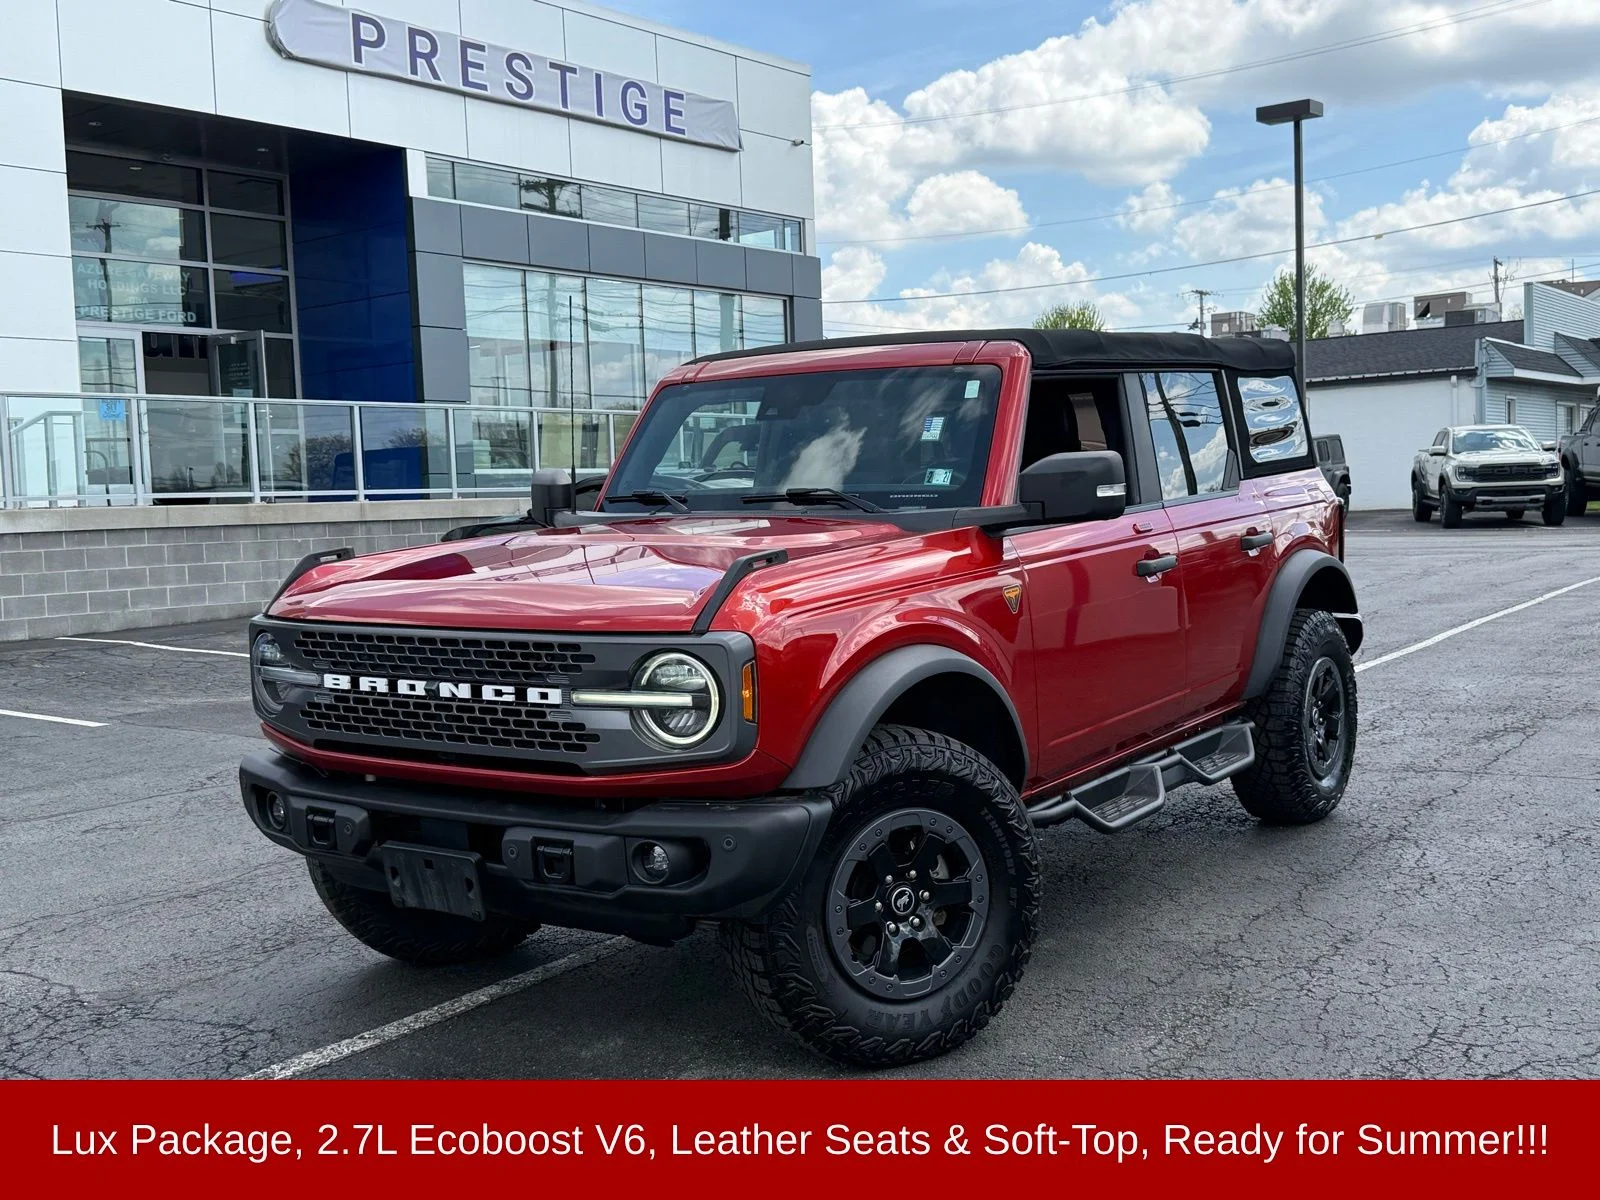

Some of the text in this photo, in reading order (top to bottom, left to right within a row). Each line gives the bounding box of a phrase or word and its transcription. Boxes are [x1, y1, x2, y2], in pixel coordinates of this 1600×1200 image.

[351, 12, 688, 136] PRESTIGE
[162, 285, 187, 296] LLC
[79, 306, 197, 323] PRESTIGE FORD
[323, 672, 563, 705] BRONCO
